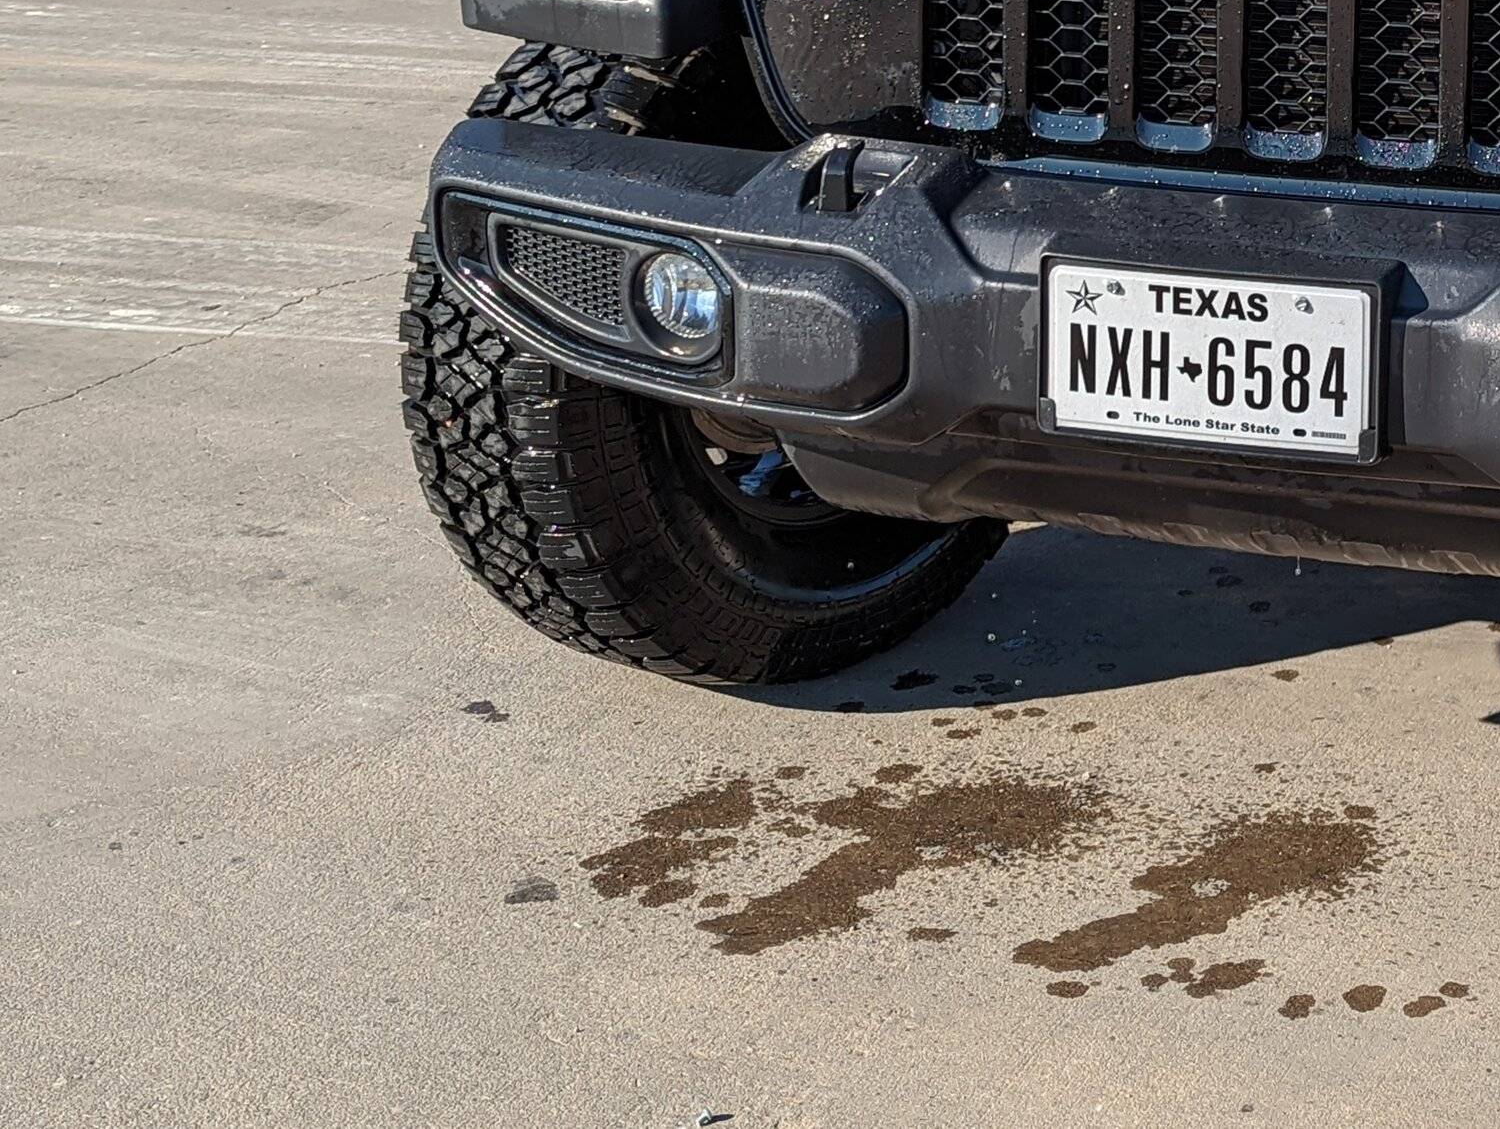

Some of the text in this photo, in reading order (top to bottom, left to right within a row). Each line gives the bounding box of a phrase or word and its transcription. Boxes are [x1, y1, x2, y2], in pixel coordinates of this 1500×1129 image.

[1148, 284, 1269, 322] TEXAS
[1069, 322, 1348, 418] NXH 6584
[1133, 411, 1281, 436] The Lone Star State
